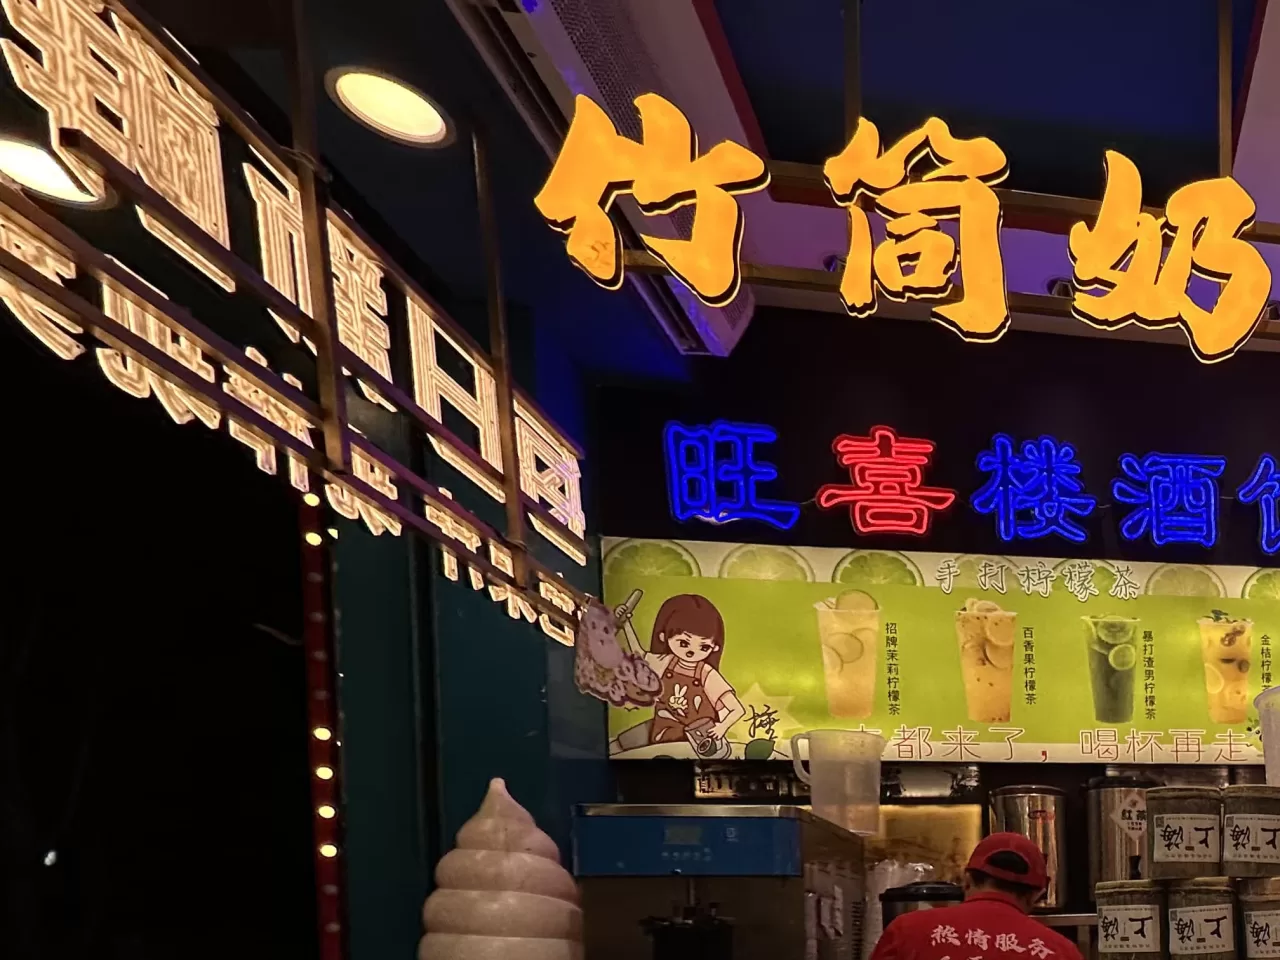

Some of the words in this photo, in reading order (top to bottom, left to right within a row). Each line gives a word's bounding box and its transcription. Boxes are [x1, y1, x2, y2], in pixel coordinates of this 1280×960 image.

[936, 559, 1140, 602] 手打柠檬茶
[885, 621, 900, 716] 招牌茉莉柠檬茶
[1022, 627, 1037, 706] 百香果柠檬茶
[1142, 630, 1156, 720] 暴打渣男柠檬茶
[931, 925, 1055, 960] 热情服务
